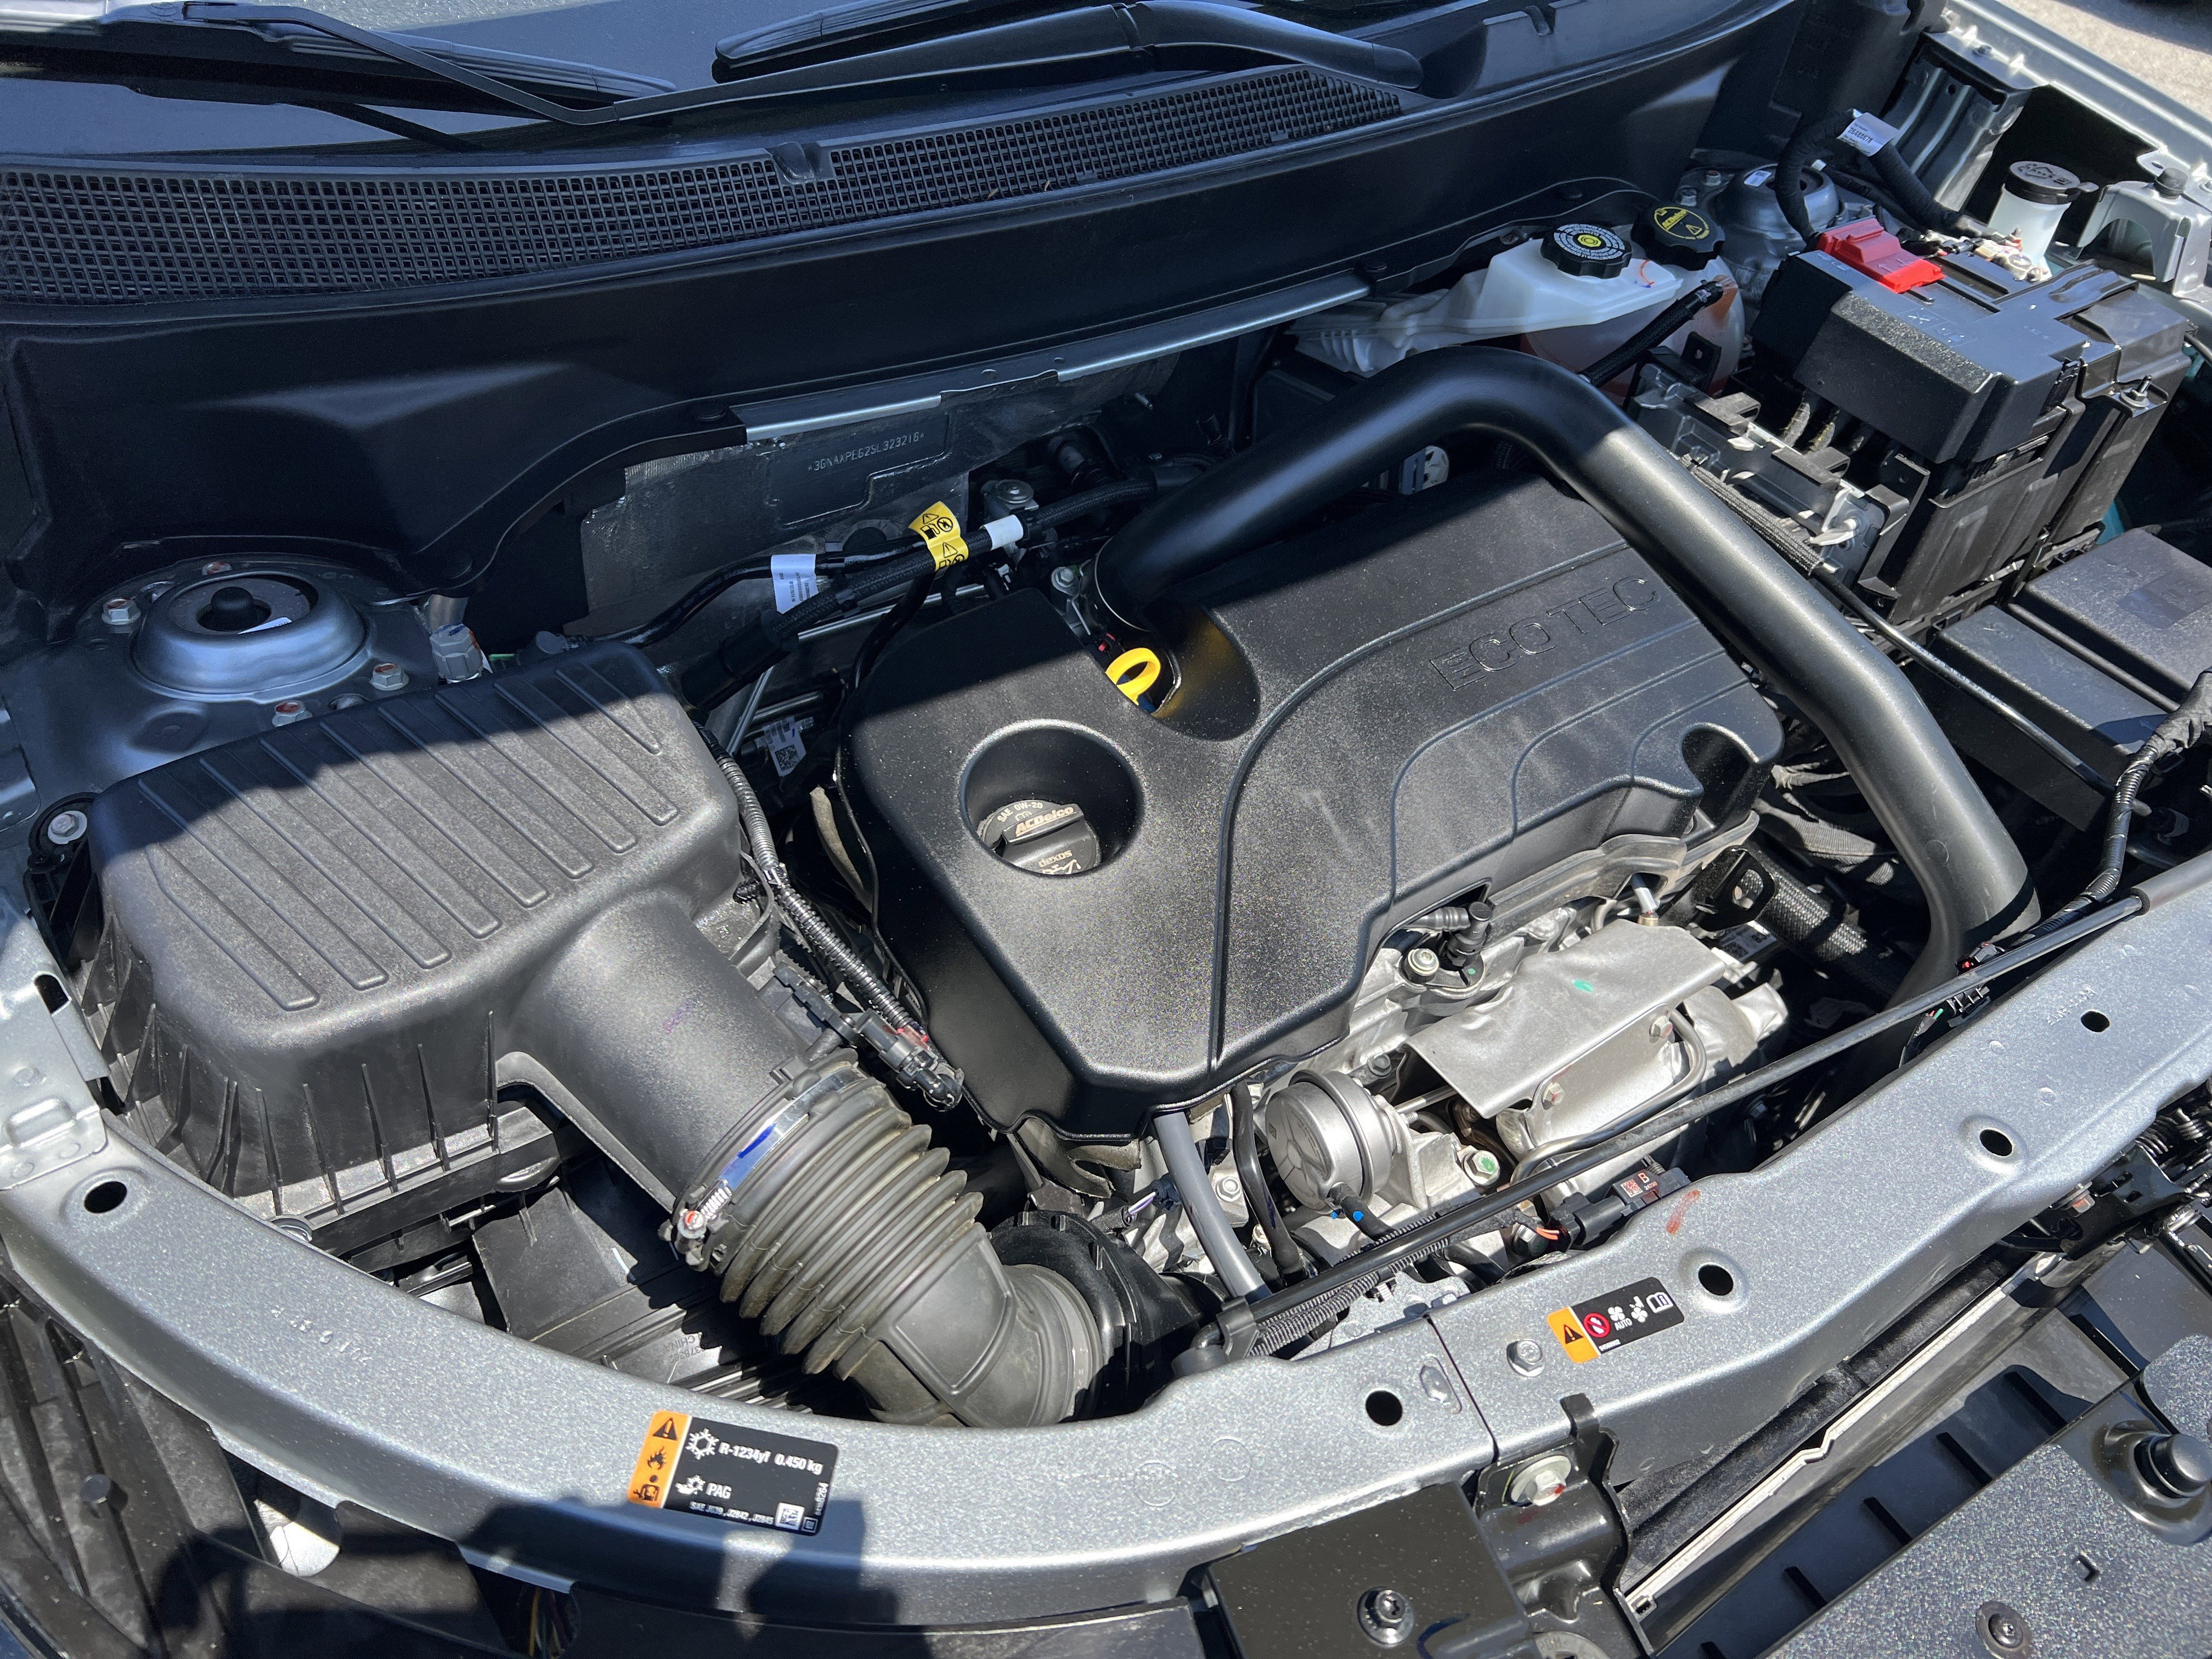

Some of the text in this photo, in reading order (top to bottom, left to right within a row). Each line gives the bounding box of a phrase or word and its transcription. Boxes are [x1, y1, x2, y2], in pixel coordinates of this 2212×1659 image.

[1429, 575, 1662, 692] ECOTEC
[997, 802, 1043, 822] SAE 0W-20
[1015, 806, 1074, 836] ACDelco
[1039, 850, 1073, 867] dexos
[1638, 1172, 1650, 1183] B
[1614, 1318, 1633, 1330] AUTO
[663, 1335, 696, 1352] CHINA
[718, 1442, 823, 1475] R-1234yf 0.450 kg
[706, 1482, 733, 1499] PAG
[689, 1501, 706, 1512] SAE
